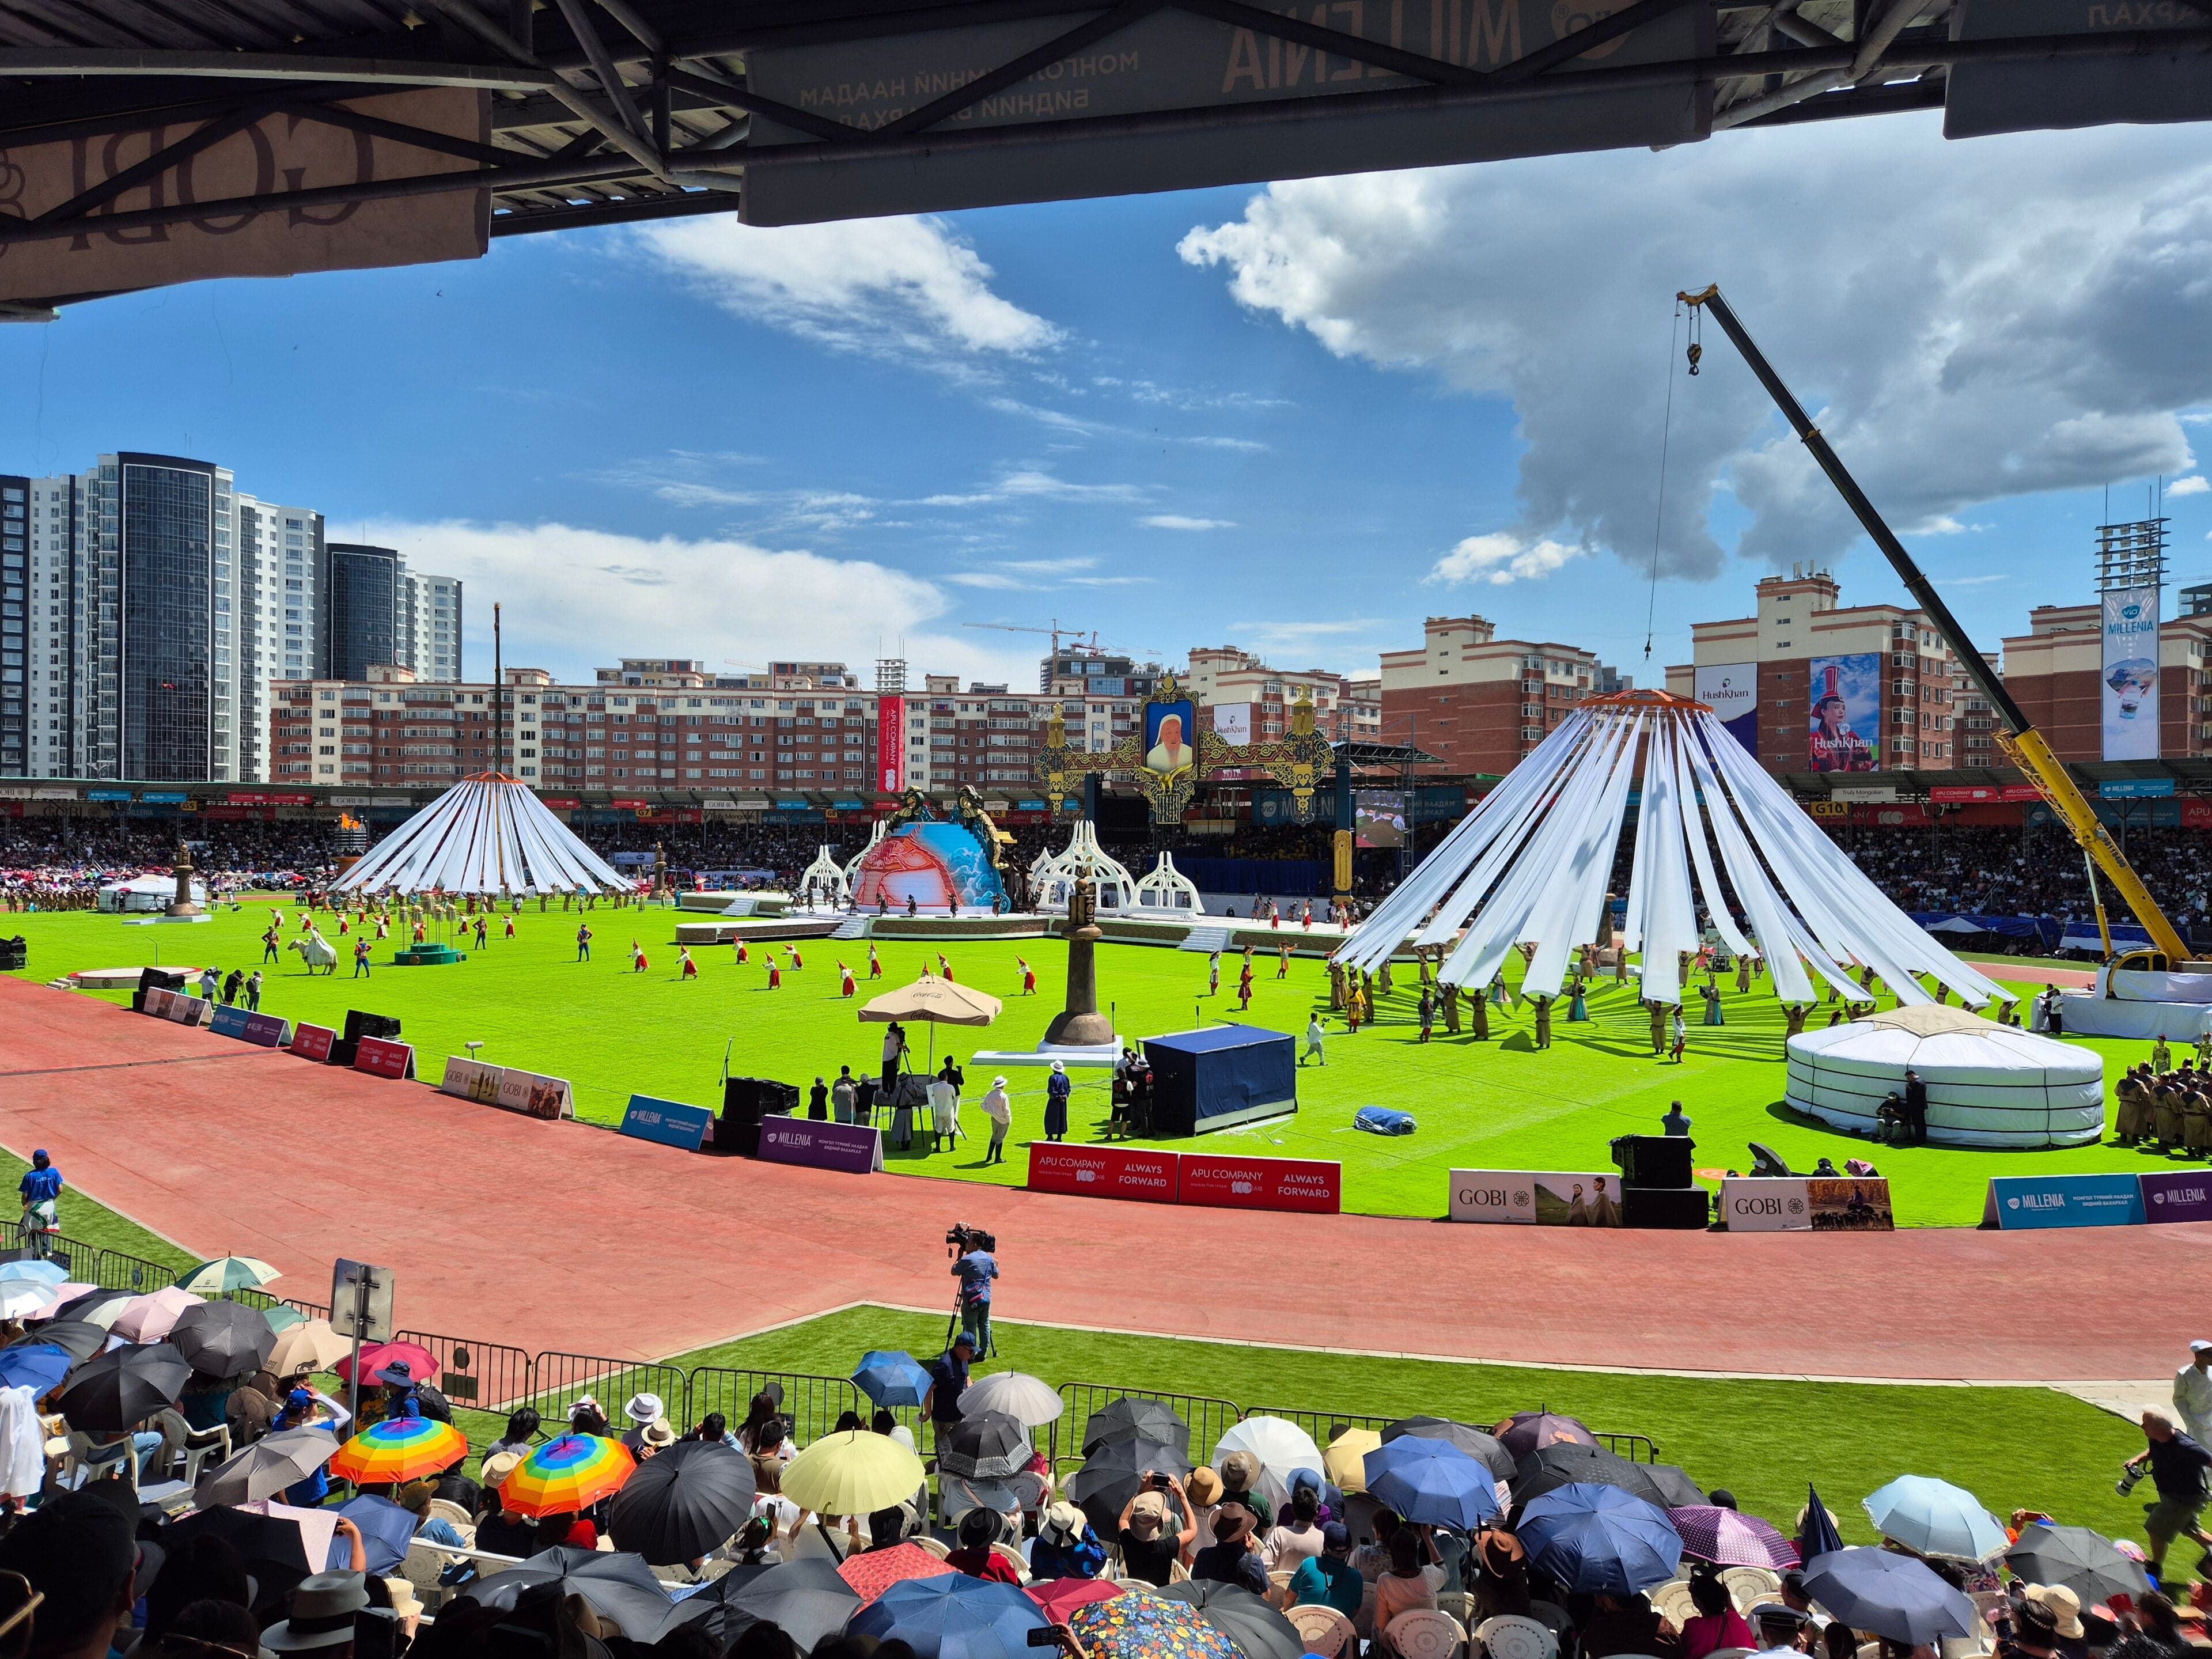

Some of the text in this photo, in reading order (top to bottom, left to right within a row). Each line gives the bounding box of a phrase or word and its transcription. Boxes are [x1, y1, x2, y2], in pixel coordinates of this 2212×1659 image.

[2108, 621, 2153, 634] MILLENIA
[1703, 690, 1749, 700] HushKhan
[1217, 725, 1247, 734] HushKhan
[1814, 736, 1873, 750] HushKhan
[43, 807, 82, 818] GOBI
[1816, 804, 1843, 813] G10
[2189, 808, 2210, 816] APU
[388, 1051, 403, 1060] ALWAYS
[384, 1060, 402, 1069] FORWARD
[446, 1070, 463, 1084] GOBI
[503, 1082, 522, 1096] GOBI
[637, 1109, 660, 1124] MILLENIA
[778, 1131, 810, 1147] MILLENIA
[1039, 1157, 1106, 1170] APU COMPANY
[1124, 1163, 1162, 1173] ALWAYS
[1119, 1175, 1166, 1187] FORWARD
[1191, 1168, 1263, 1181] APU COMPANY
[1283, 1174, 1324, 1184] ALWAYS
[1278, 1186, 1330, 1198] FORWARD
[1459, 1188, 1506, 1206] GOBI
[2166, 1188, 2207, 1203] MILLENIA
[1735, 1198, 1782, 1215] GOBI
[2022, 1193, 2066, 1208] MILLENIA
